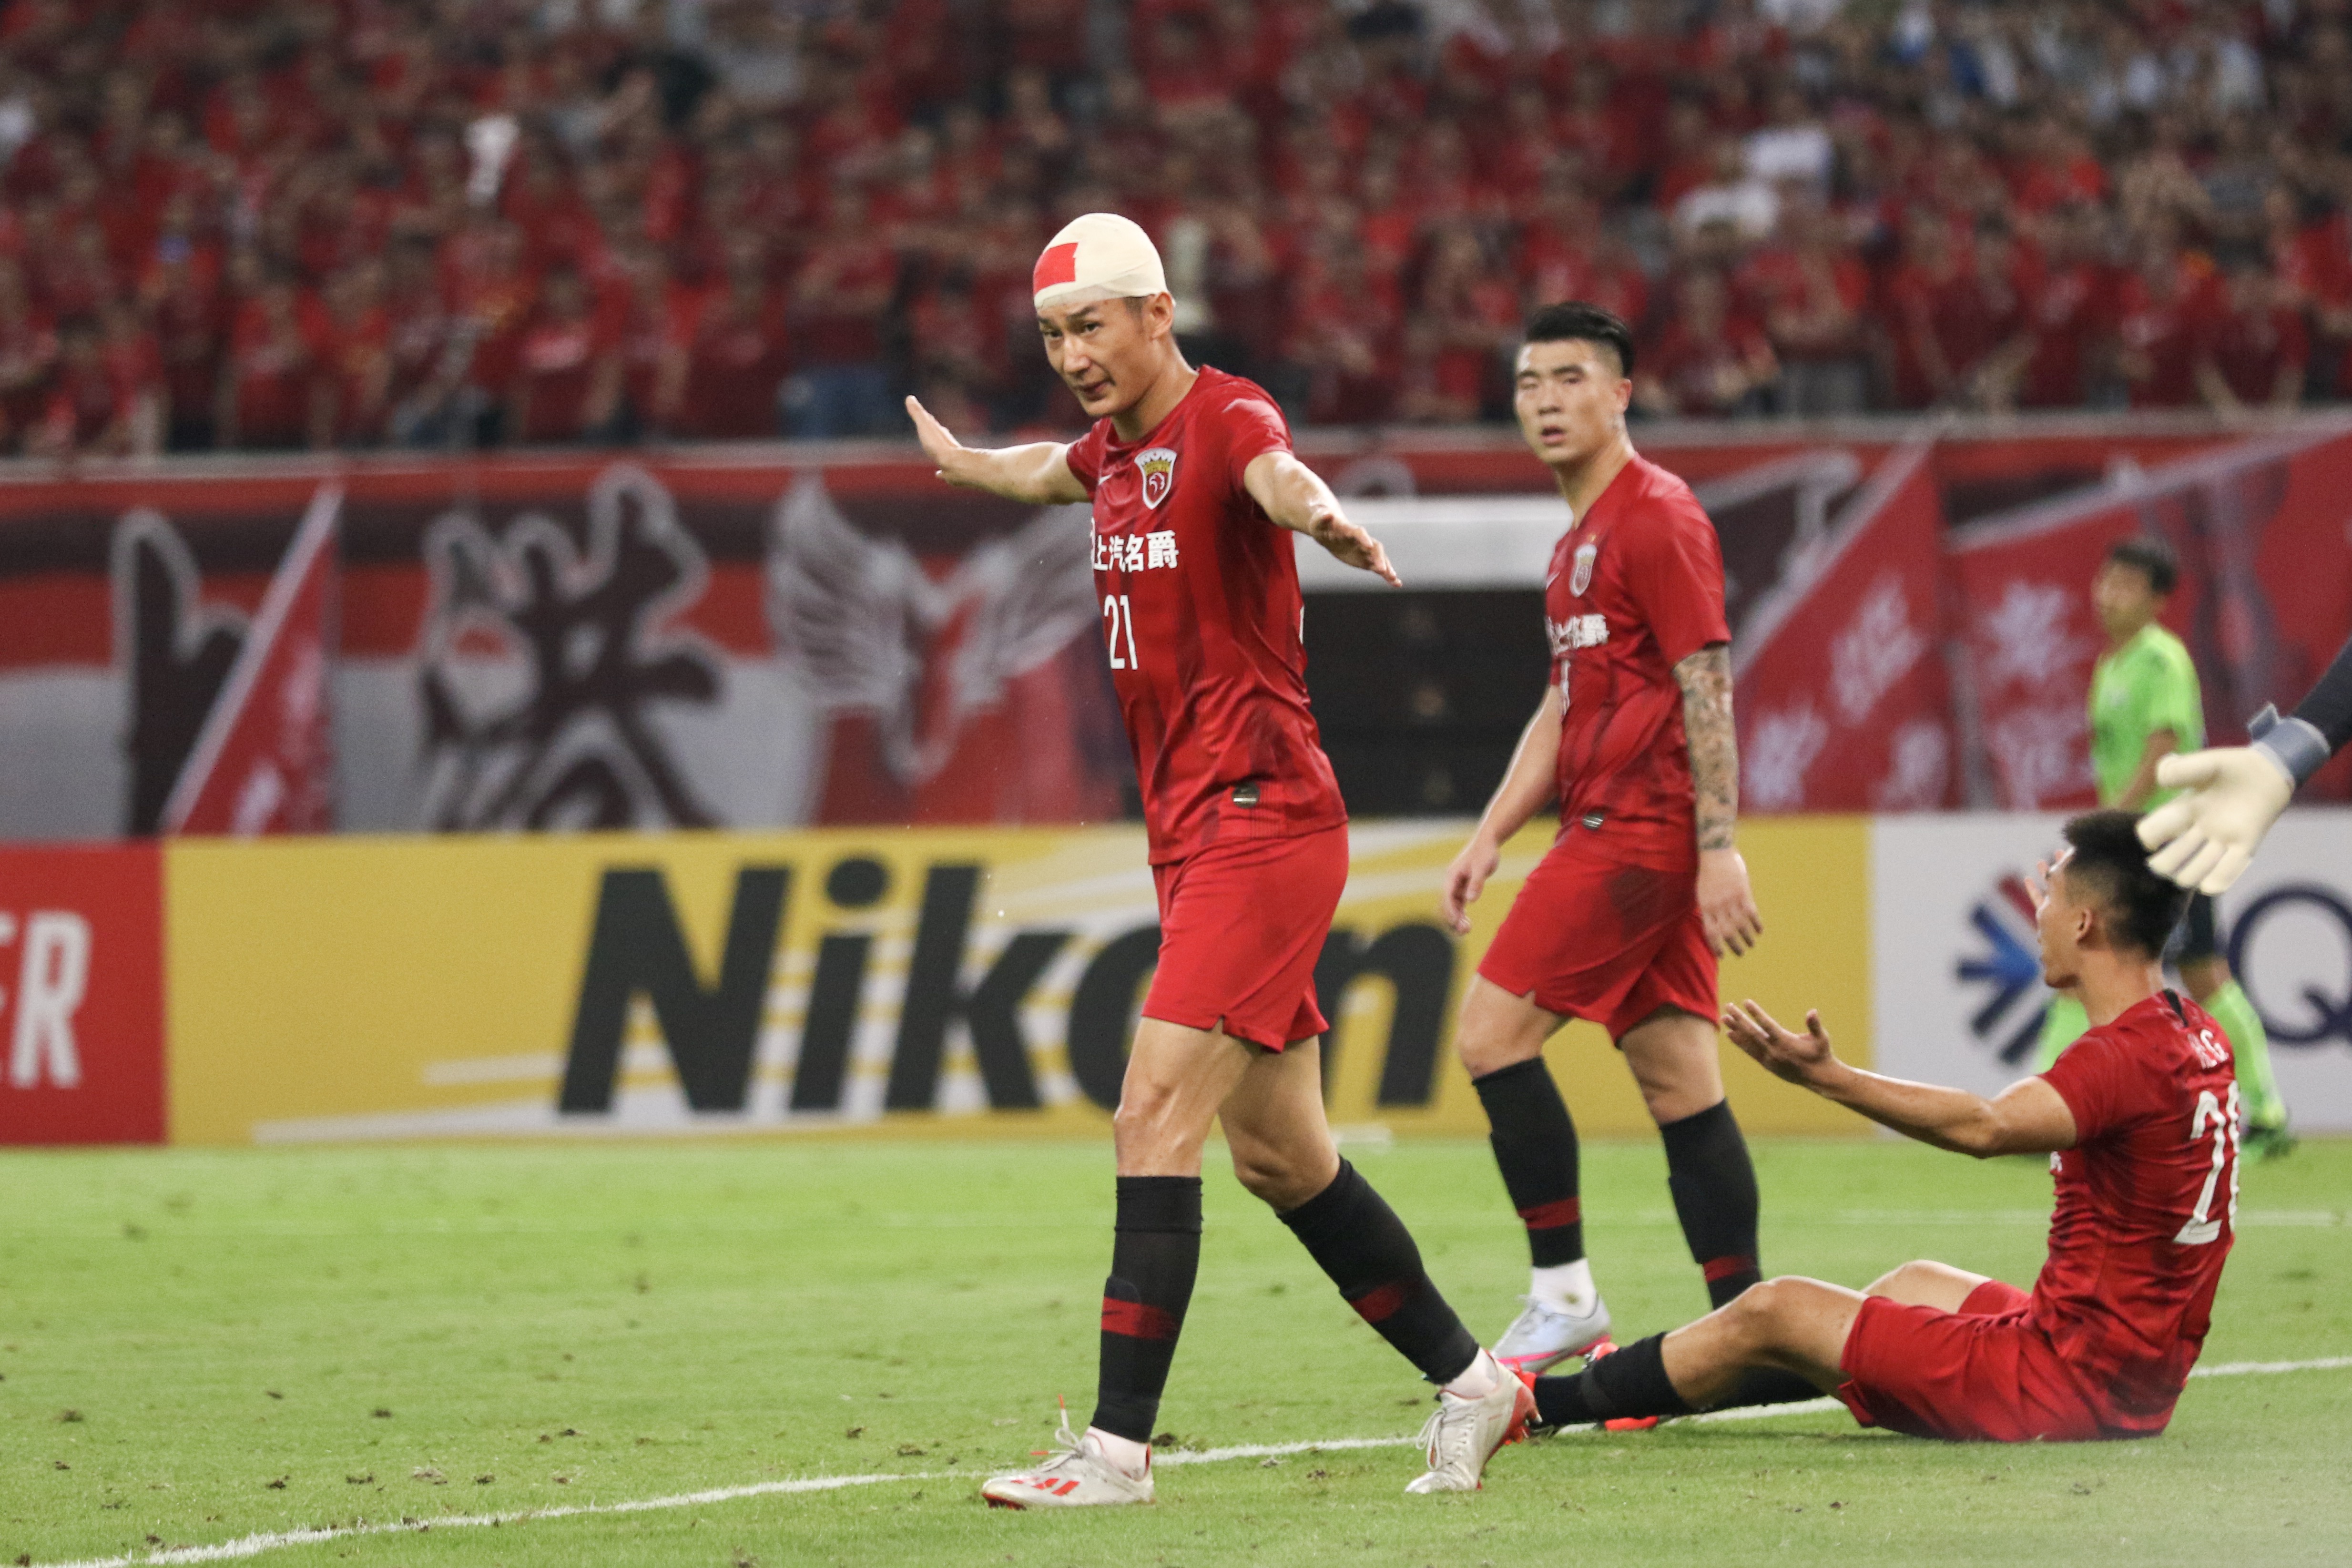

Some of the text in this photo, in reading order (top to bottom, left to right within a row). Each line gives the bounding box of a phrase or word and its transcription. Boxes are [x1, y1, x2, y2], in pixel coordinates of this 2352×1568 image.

[1094, 529, 1180, 573] 上汽名爵
[1103, 594, 1139, 670] 21
[0, 910, 92, 1089] R
